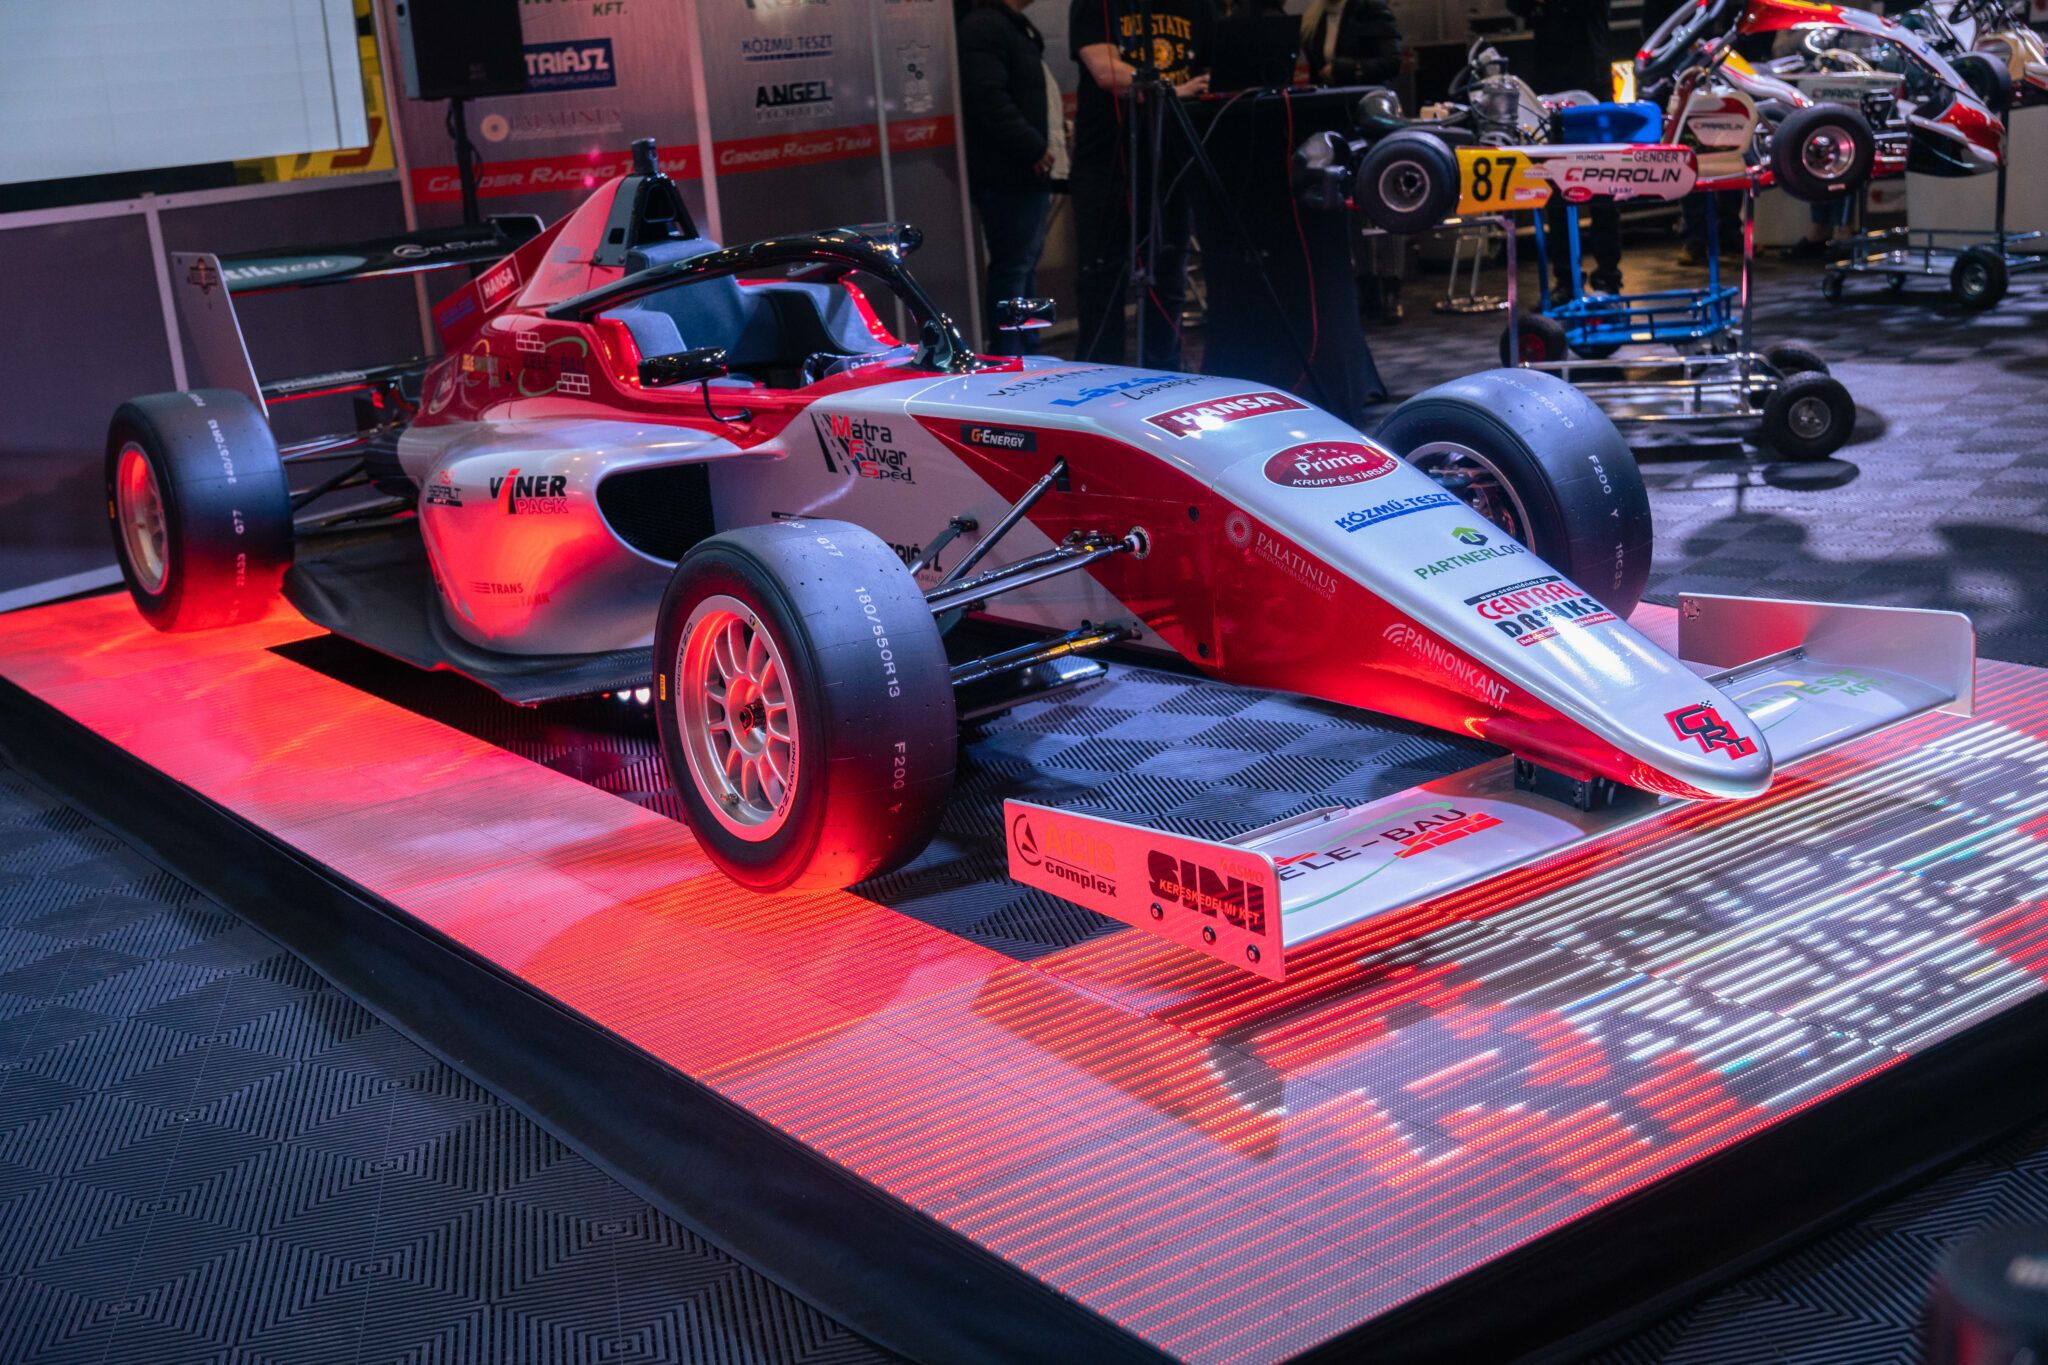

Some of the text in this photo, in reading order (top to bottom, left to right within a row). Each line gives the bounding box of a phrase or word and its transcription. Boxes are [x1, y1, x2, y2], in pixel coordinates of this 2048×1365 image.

[593, 3, 628, 16] KFT.
[755, 81, 833, 108] ANGEL
[1633, 151, 1681, 163] GENDER
[428, 174, 524, 193] GEDER
[621, 159, 686, 178] TAM
[1472, 156, 1517, 202] 87
[482, 267, 515, 299] HANSA
[1170, 395, 1285, 428] HANSA
[861, 460, 913, 482] Sped
[1293, 476, 1337, 486] KRUPP
[1339, 473, 1354, 484] ÉS
[1356, 465, 1386, 480] TÁRSA
[1588, 454, 1613, 495] F200
[1610, 508, 1620, 518] Y
[232, 509, 245, 534] G77
[515, 498, 569, 515] PACK
[817, 537, 844, 558] G77
[1256, 532, 1338, 595] PALATINUS
[1414, 542, 1525, 580] PARTNERLOG
[491, 583, 524, 594] TRANS
[1477, 582, 1584, 620] CENTRAL
[854, 586, 900, 698] 180/550R13
[677, 646, 685, 697] RACING
[1404, 627, 1510, 705] PANNONKANT
[788, 741, 796, 794] RACING
[894, 741, 906, 790] F200
[1044, 823, 1116, 874] ACIS
[1045, 861, 1117, 898] complex
[1148, 850, 1266, 937] SINI
[1159, 879, 1260, 925] KERESKEDELMI KFT
